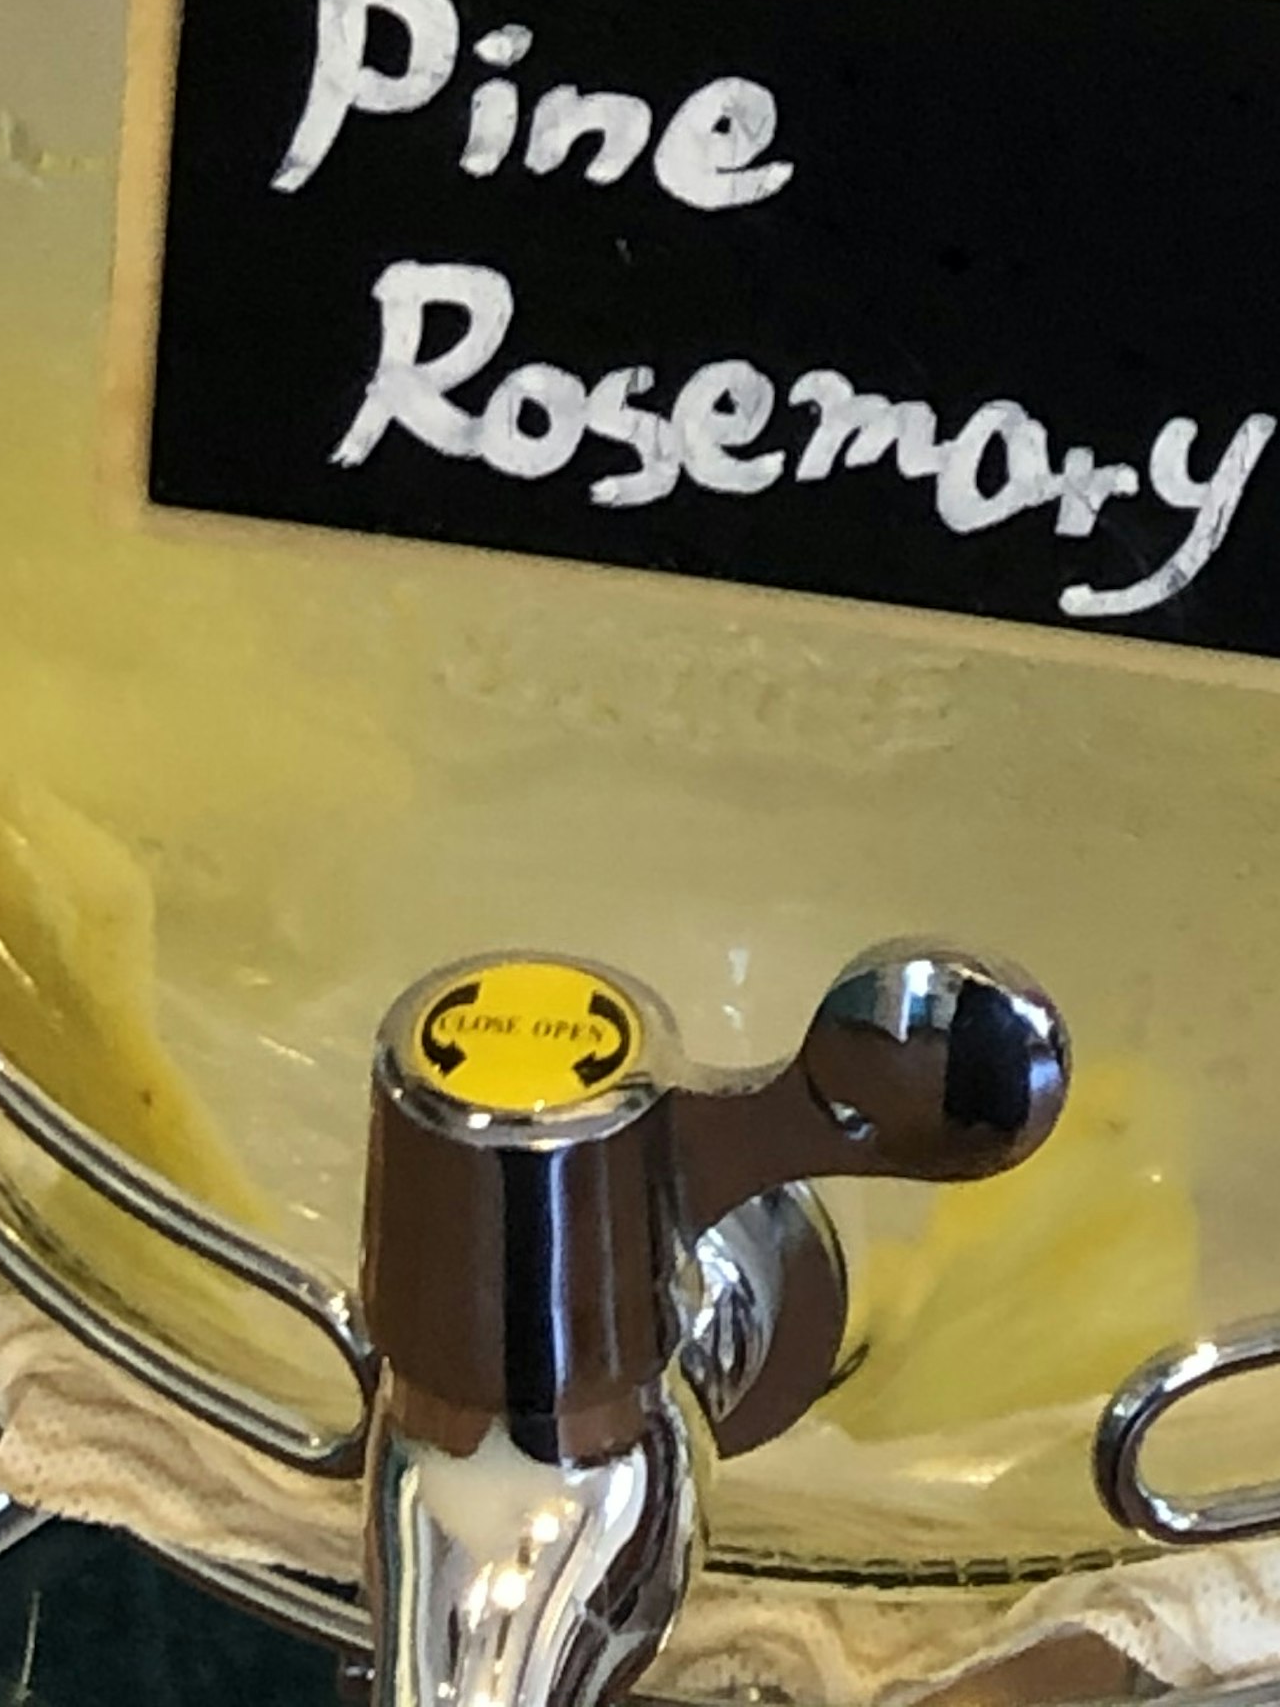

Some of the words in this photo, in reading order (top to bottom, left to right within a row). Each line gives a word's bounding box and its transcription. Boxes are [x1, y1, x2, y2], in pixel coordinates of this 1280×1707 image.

[330, 259, 1276, 617] Rosemary
[437, 1014, 518, 1035] CLOSE
[531, 1019, 604, 1043] OPEN
